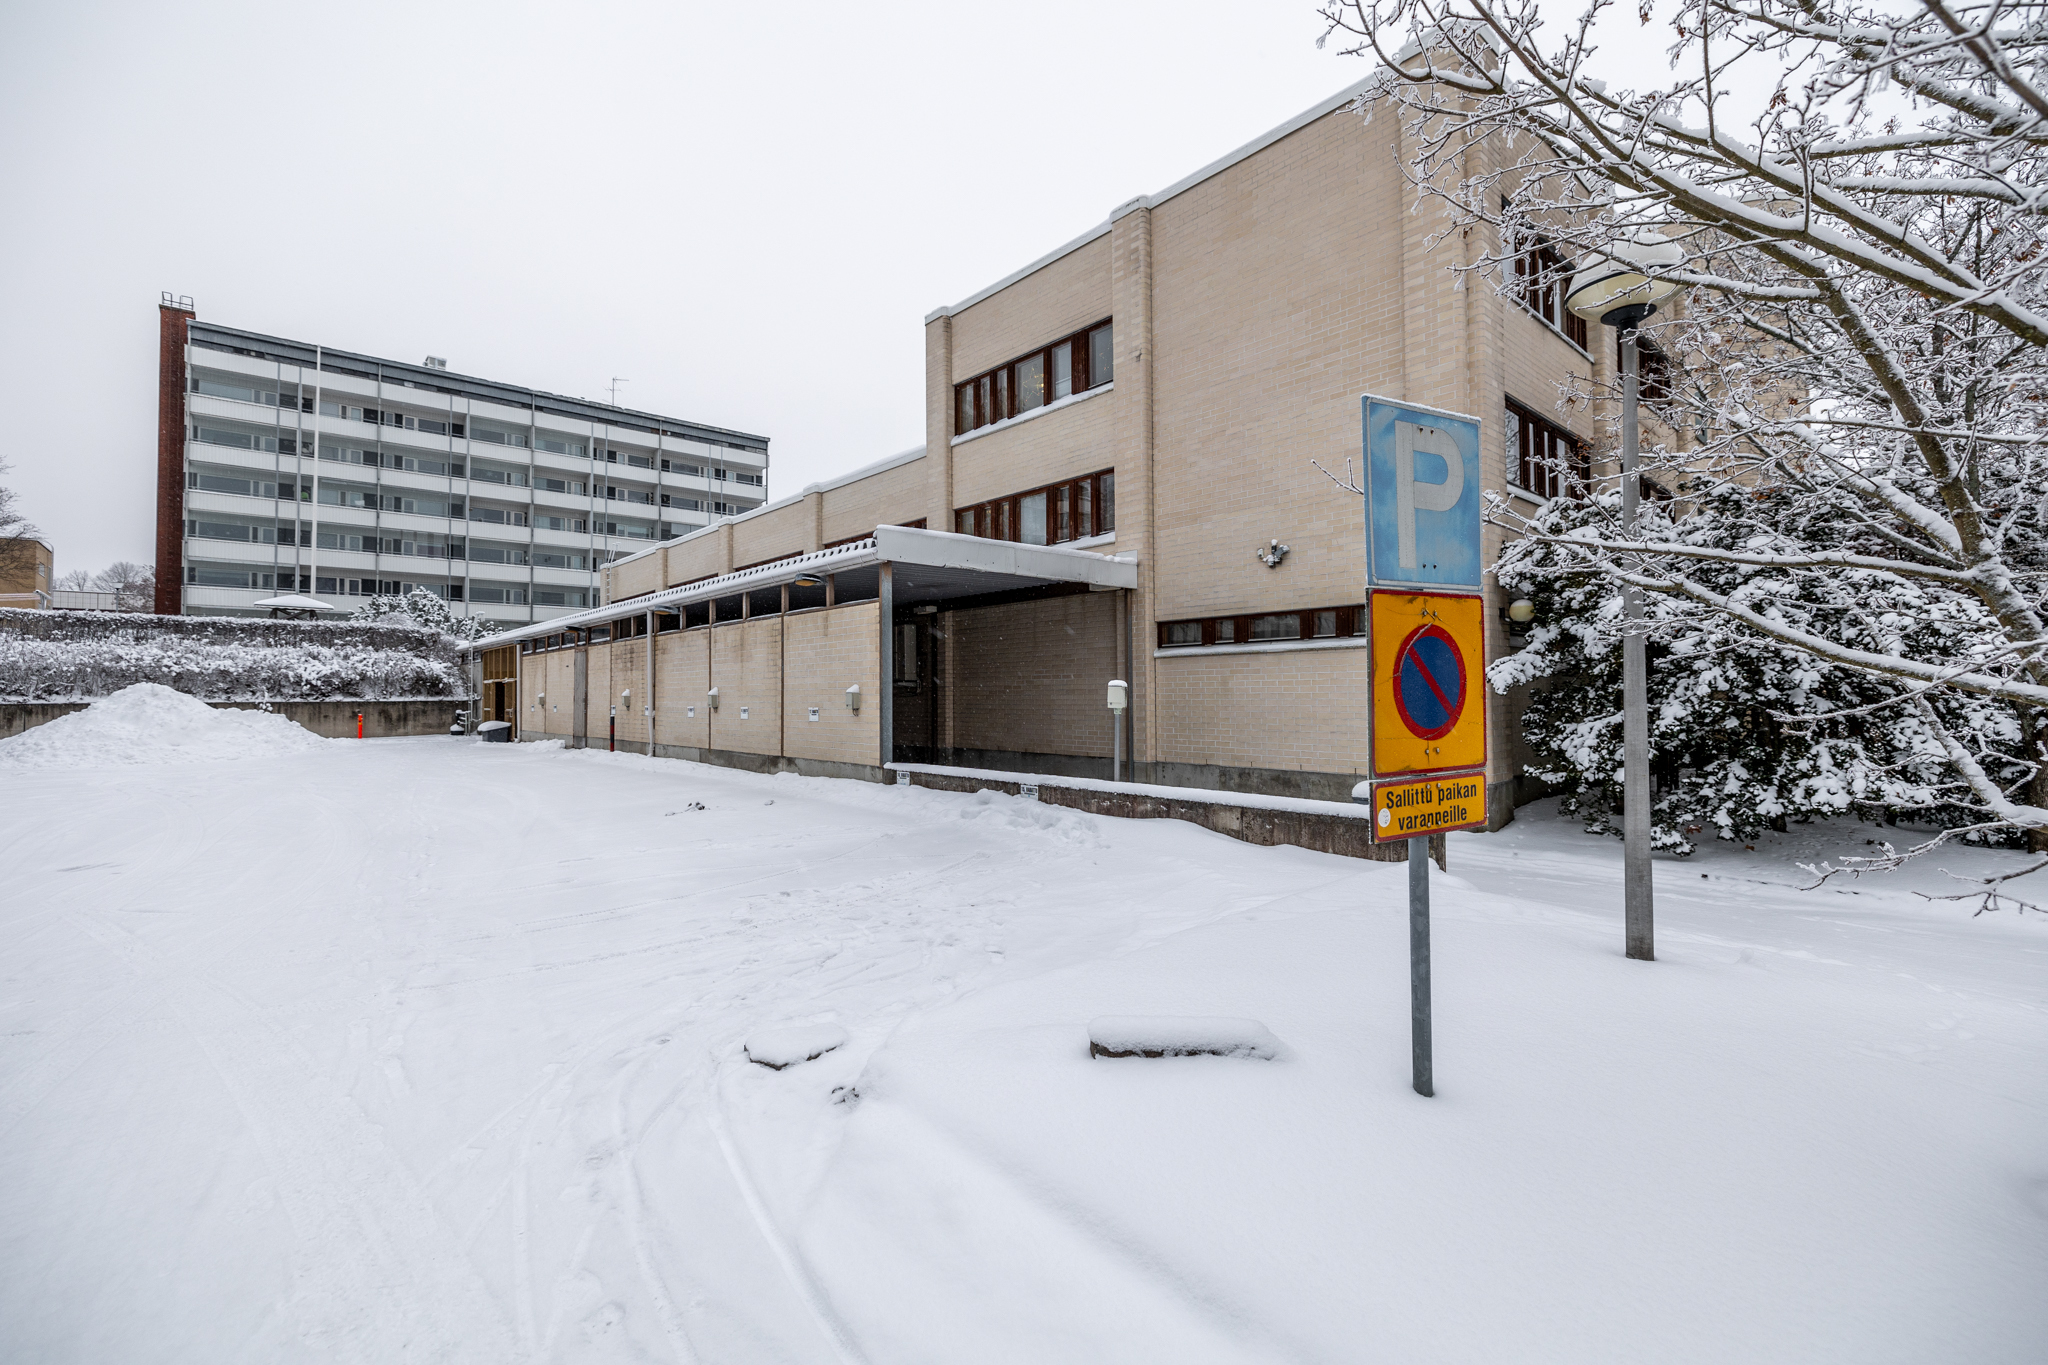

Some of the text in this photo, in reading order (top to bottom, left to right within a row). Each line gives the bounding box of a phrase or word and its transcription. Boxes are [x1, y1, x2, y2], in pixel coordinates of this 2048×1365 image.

[1394, 420, 1464, 569] P
[1386, 783, 1477, 809] Sallittu paikan
[1398, 804, 1467, 831] varanneille
